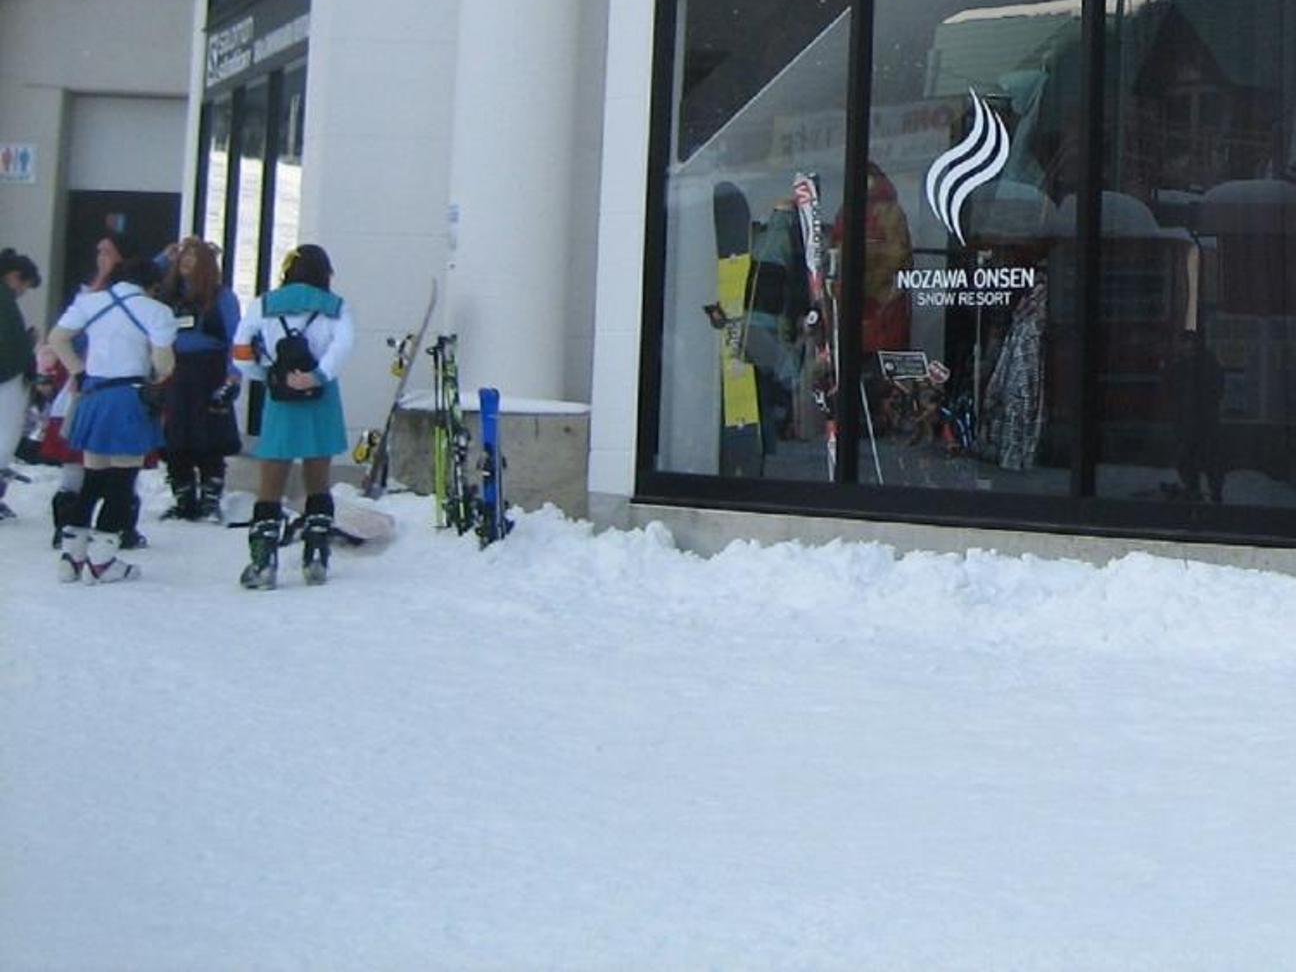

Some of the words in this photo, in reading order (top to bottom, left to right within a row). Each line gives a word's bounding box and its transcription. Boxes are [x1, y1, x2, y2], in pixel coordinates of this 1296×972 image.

[898, 269, 967, 288] NOZAWA
[974, 268, 1035, 288] ONSEN
[916, 292, 956, 306] SNOW
[958, 291, 1012, 306] RESORT
